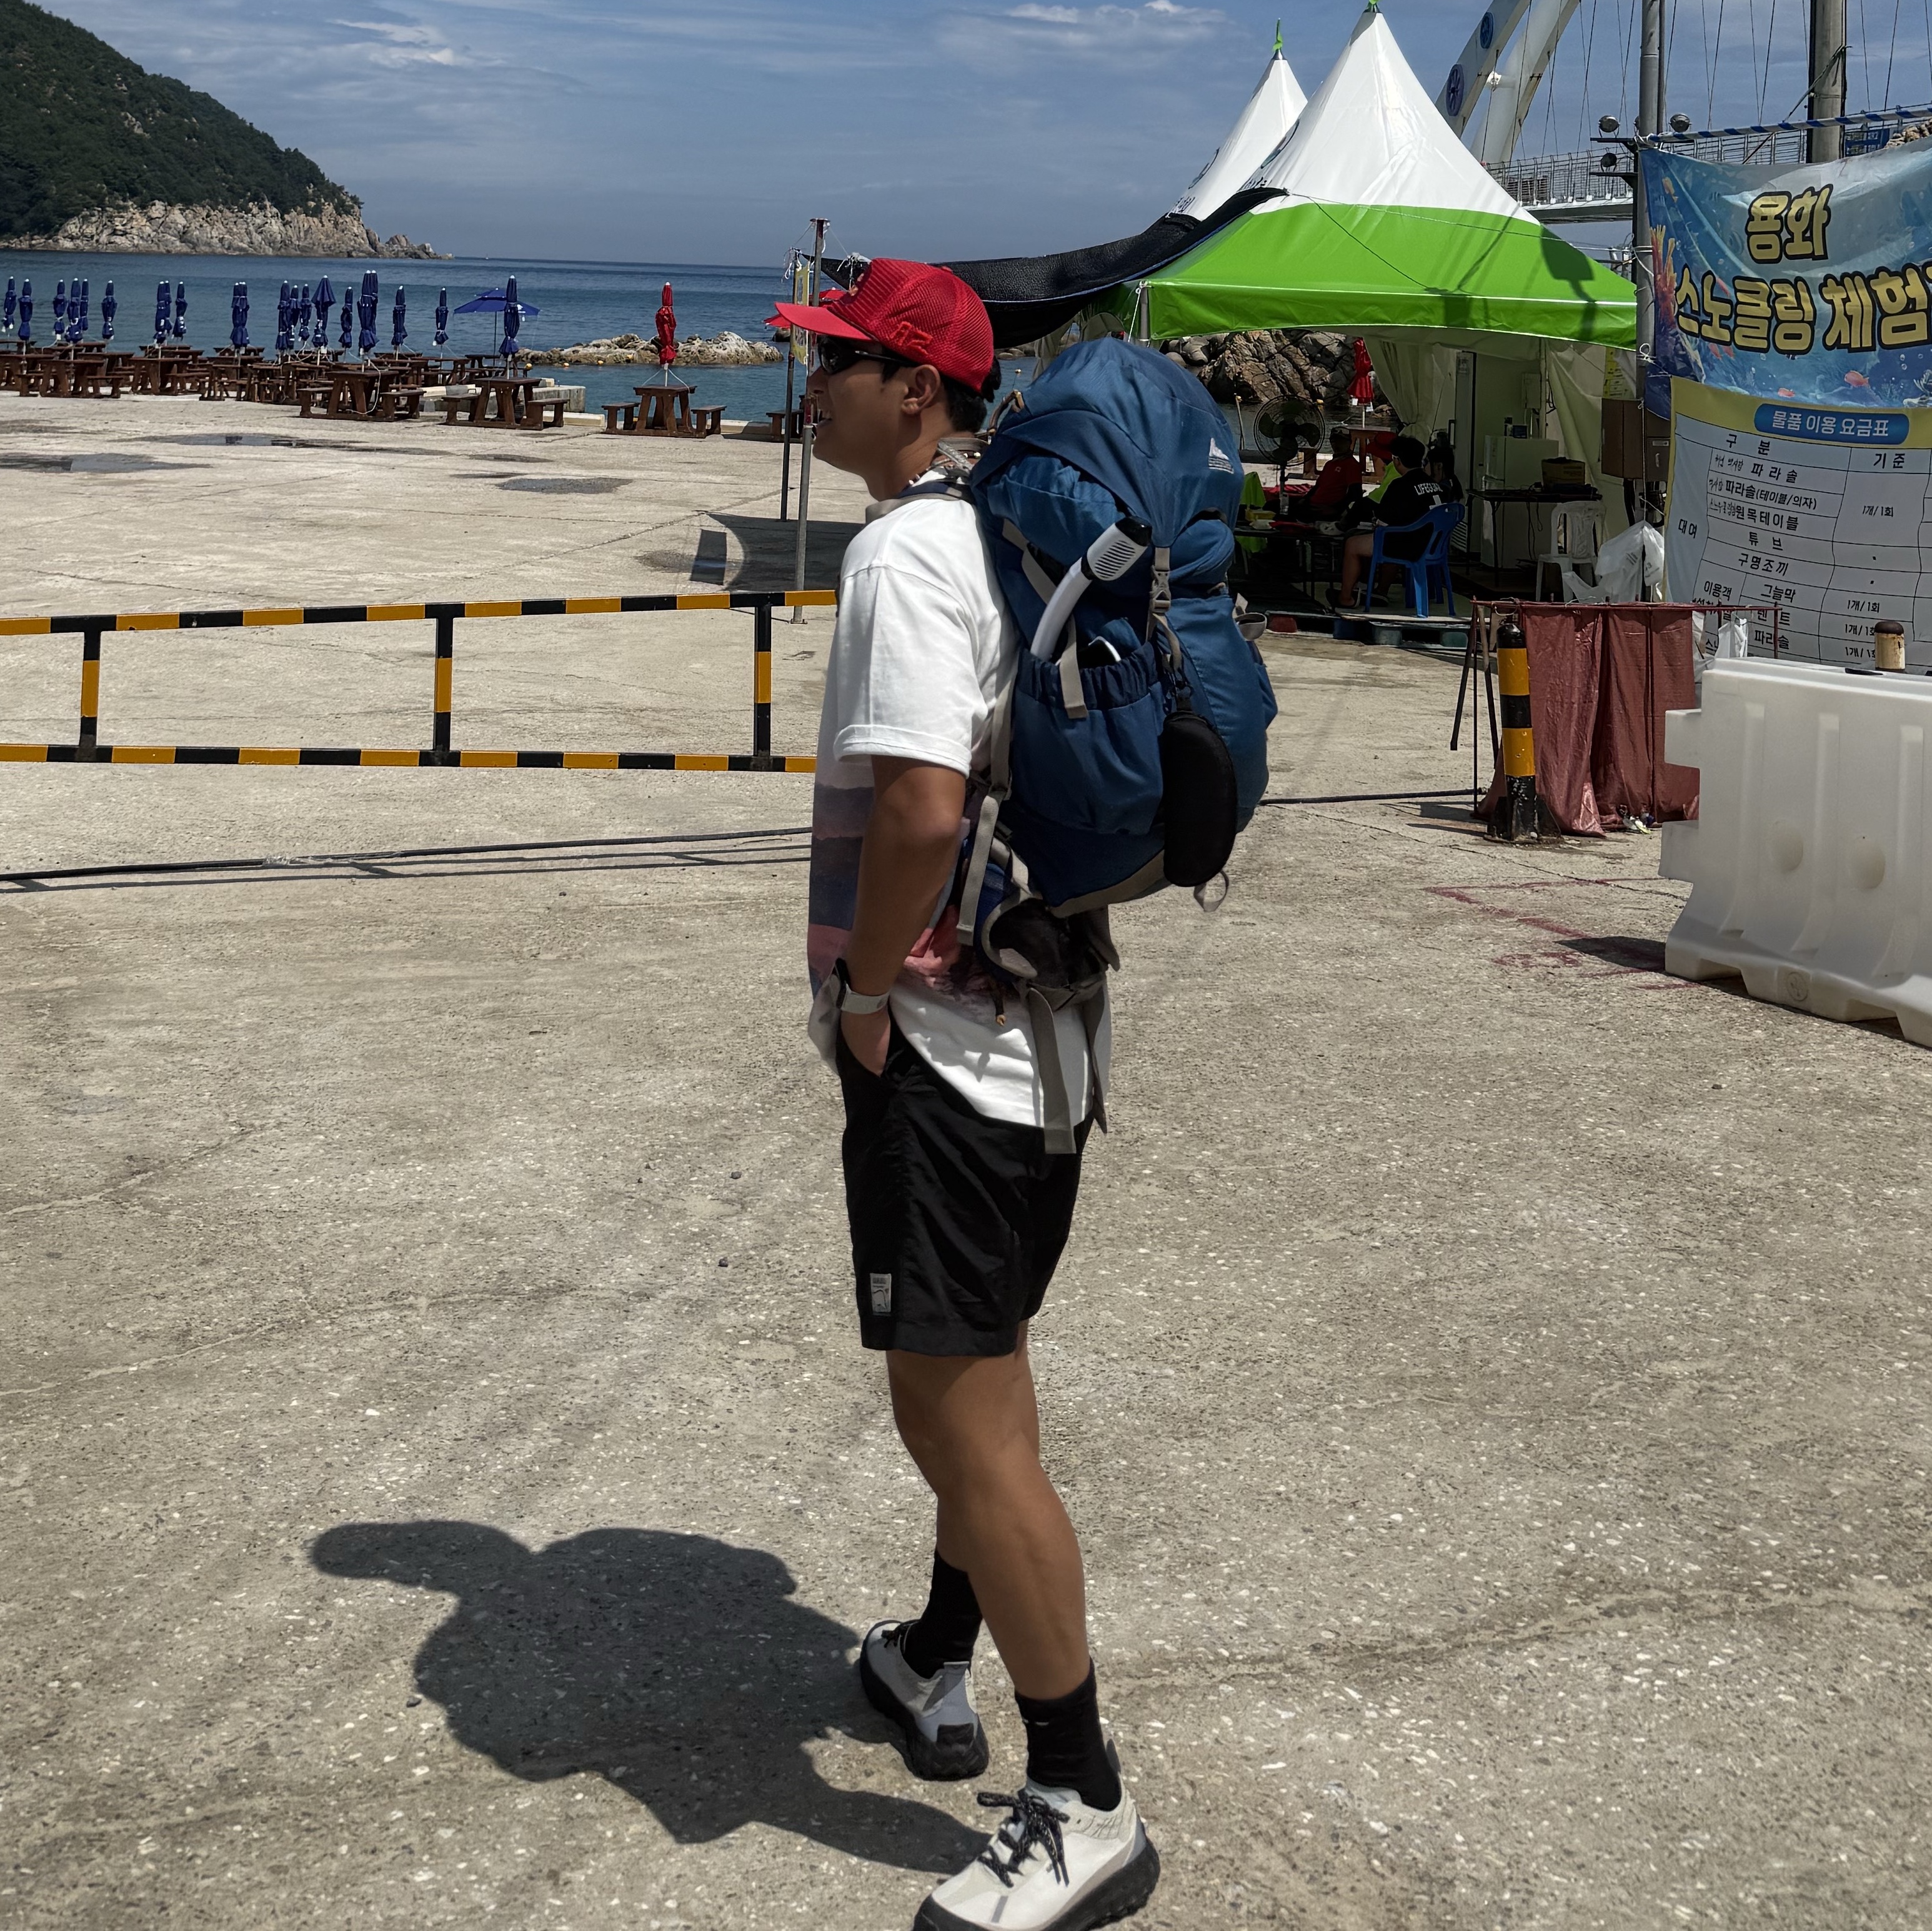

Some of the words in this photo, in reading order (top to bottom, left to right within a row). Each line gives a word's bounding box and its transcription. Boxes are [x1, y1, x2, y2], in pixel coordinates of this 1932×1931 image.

[1745, 184, 1833, 264] 용화
[1676, 263, 1816, 355] 스노클링
[1818, 262, 1932, 353] 체험
[1772, 410, 1802, 431] 물품
[1805, 415, 1836, 435] 이용
[1839, 418, 1890, 437] 요금표
[1678, 519, 1698, 539] 대여
[1738, 552, 1790, 577] 구명조끼
[1703, 580, 1733, 602] 이용객
[1760, 583, 1796, 603] 그늘막
